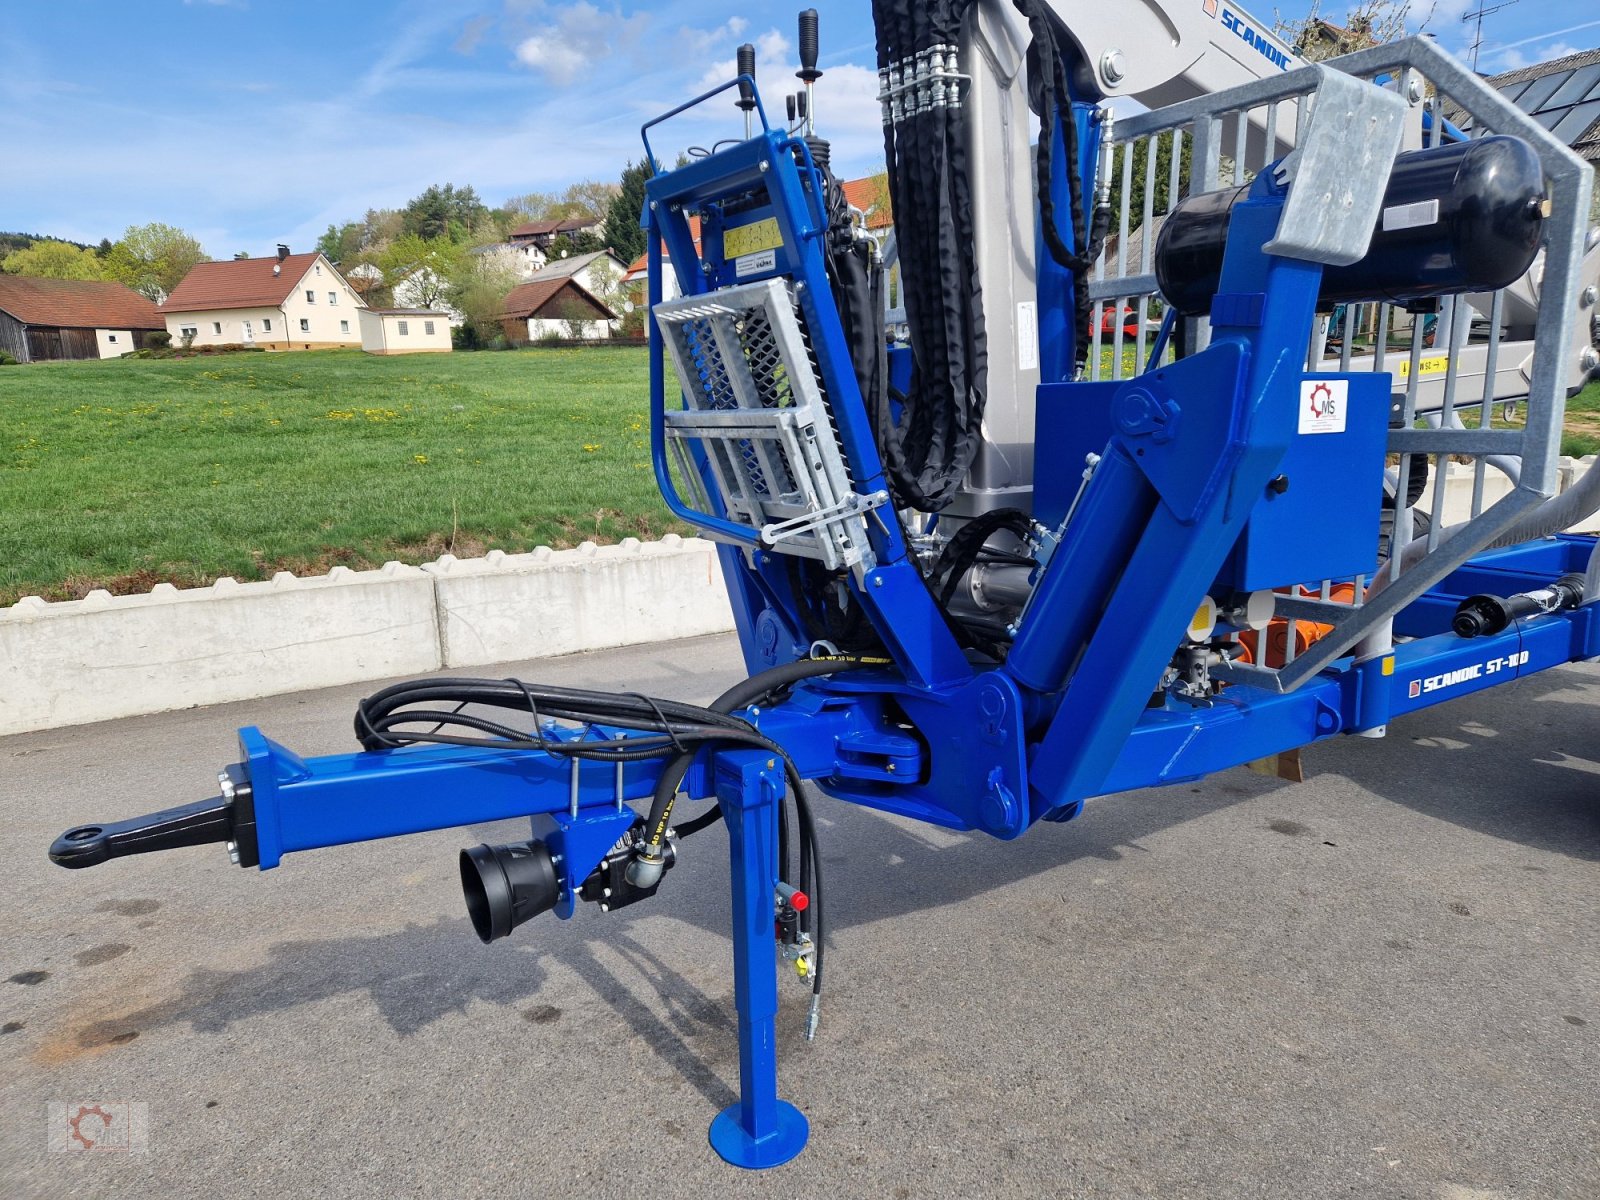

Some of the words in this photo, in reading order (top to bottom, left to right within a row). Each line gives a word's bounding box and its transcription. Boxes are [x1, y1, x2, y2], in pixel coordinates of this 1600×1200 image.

[1221, 8, 1292, 72] SCANDIC
[1321, 400, 1336, 415] MS
[1423, 663, 1483, 693] SCANDIC
